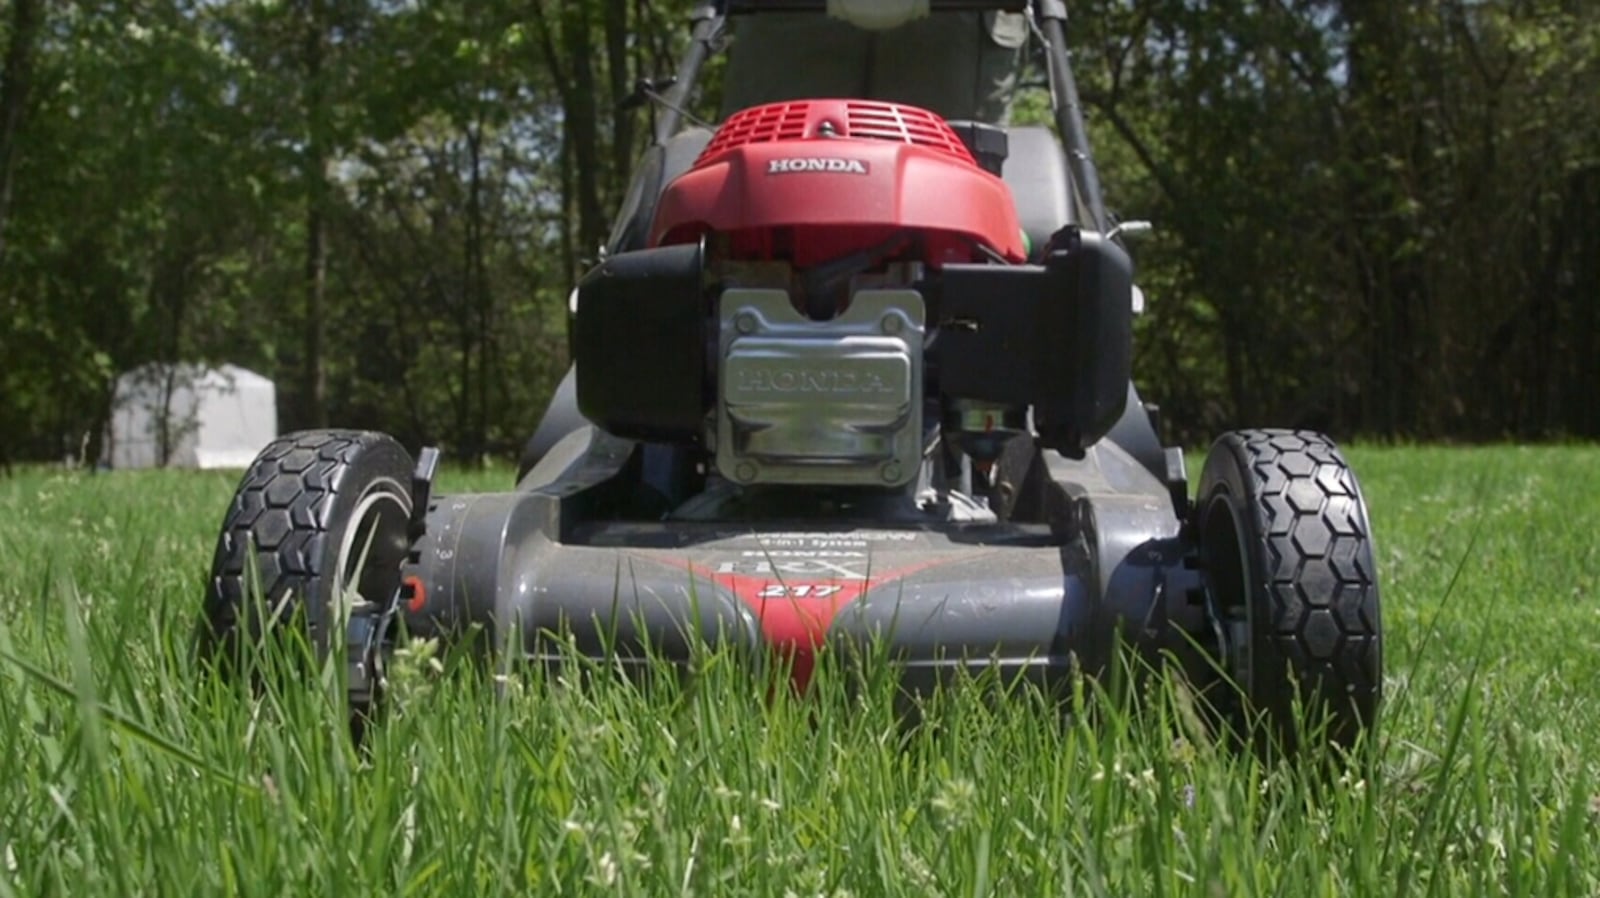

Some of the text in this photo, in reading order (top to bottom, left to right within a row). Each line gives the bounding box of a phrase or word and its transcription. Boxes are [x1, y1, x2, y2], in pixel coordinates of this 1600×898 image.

[768, 157, 867, 174] HONDA
[737, 367, 894, 393] HONDA
[741, 550, 866, 558] HONDA
[756, 584, 844, 598] 217
